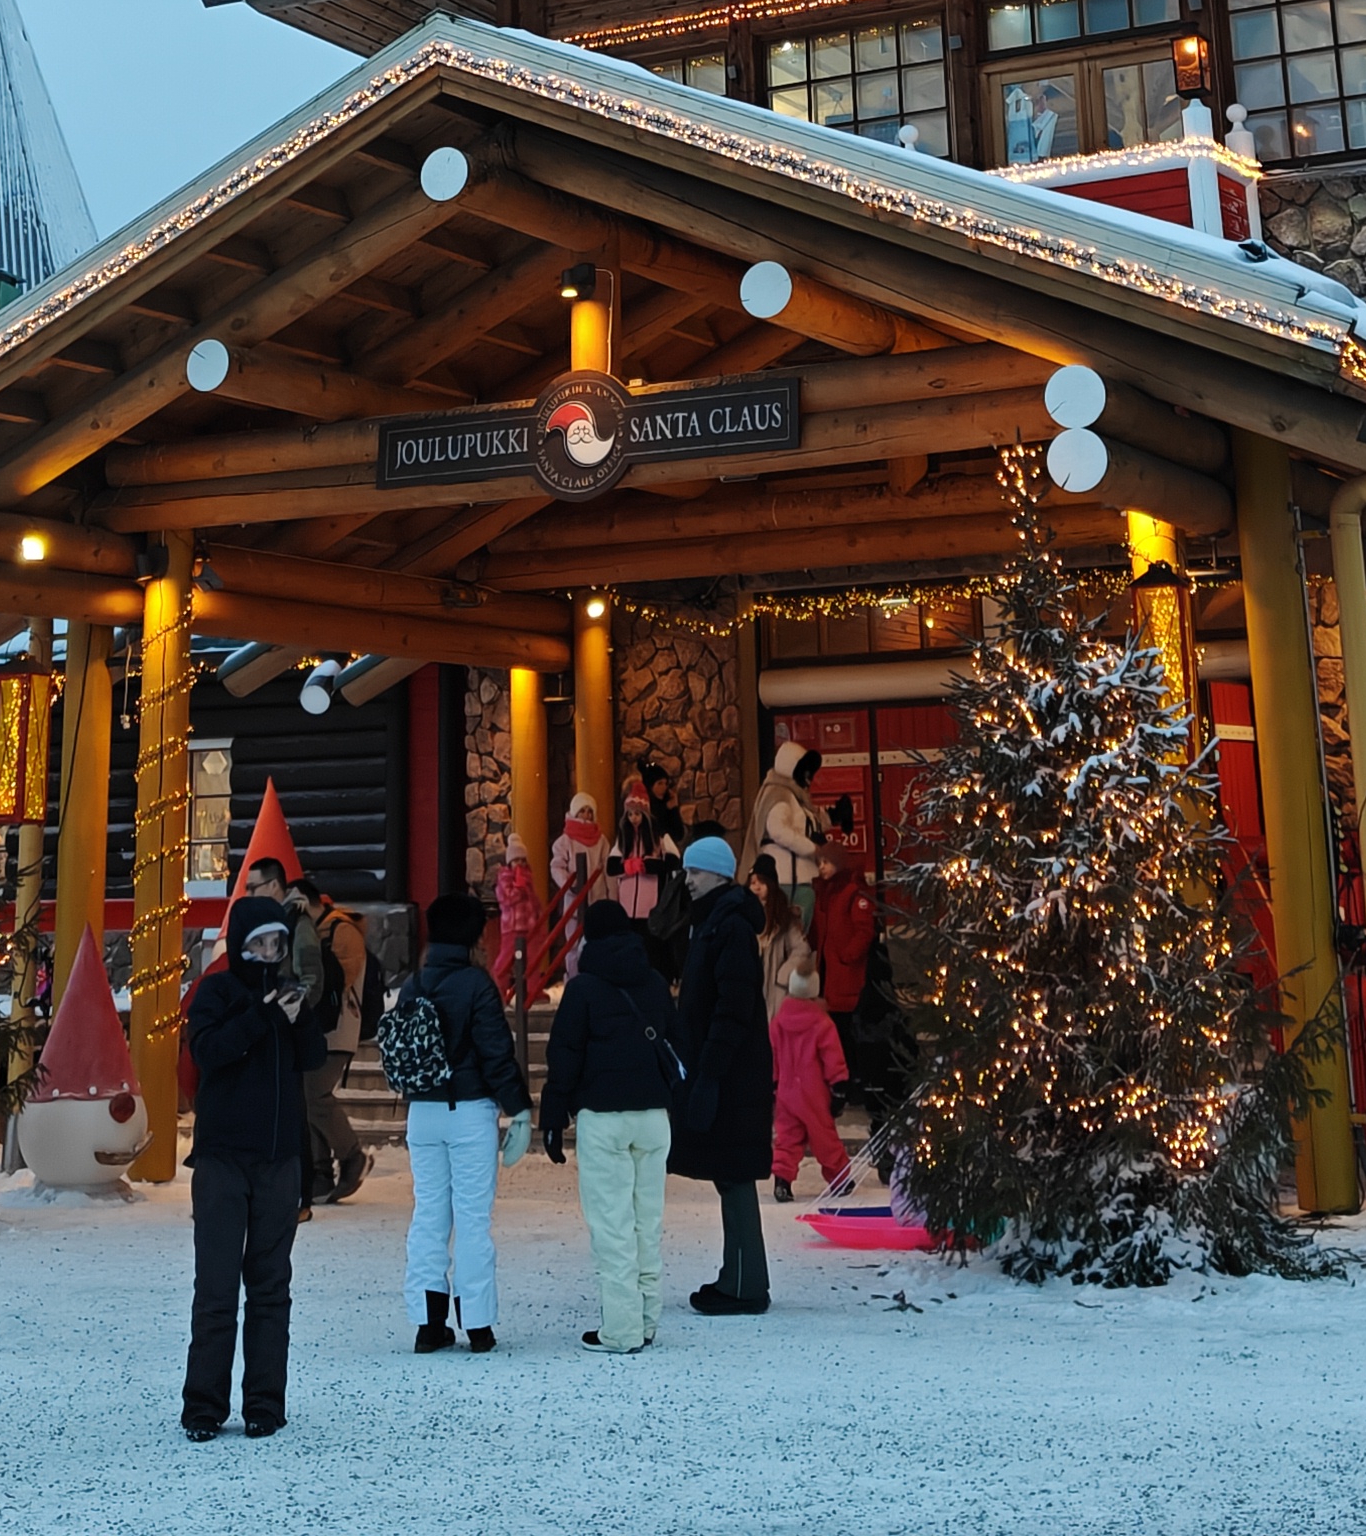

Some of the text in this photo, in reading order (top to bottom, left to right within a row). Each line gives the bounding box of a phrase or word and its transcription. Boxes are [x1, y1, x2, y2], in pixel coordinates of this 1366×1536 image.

[395, 402, 783, 469] JOULUPUKKI SANTA CLAUS
[561, 476, 595, 488] CLAUS
